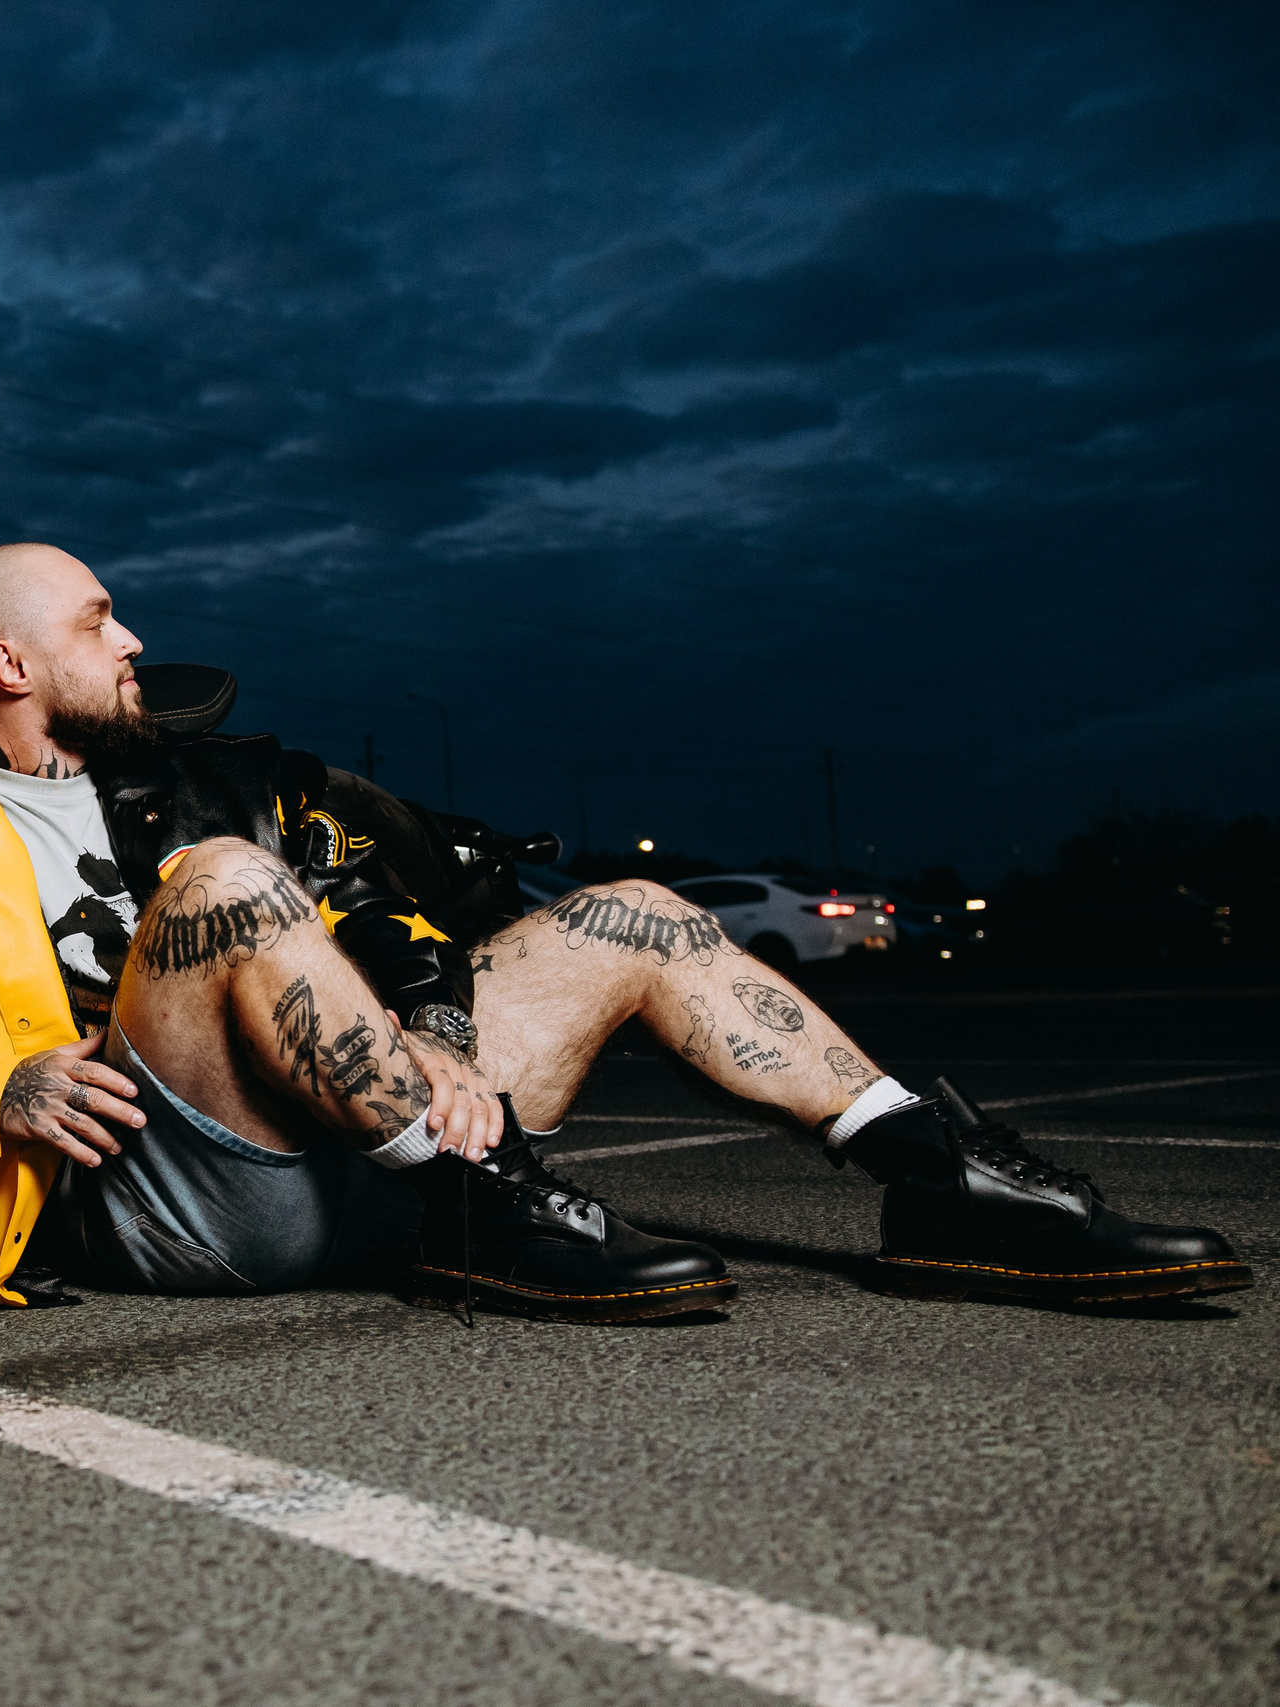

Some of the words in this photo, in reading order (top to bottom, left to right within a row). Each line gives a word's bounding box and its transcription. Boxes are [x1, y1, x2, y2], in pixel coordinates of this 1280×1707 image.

[345, 1035, 367, 1057] DAD
[733, 1040, 760, 1060] MORE
[736, 1046, 782, 1071] TATTOOS
[343, 1062, 368, 1087] MOM
